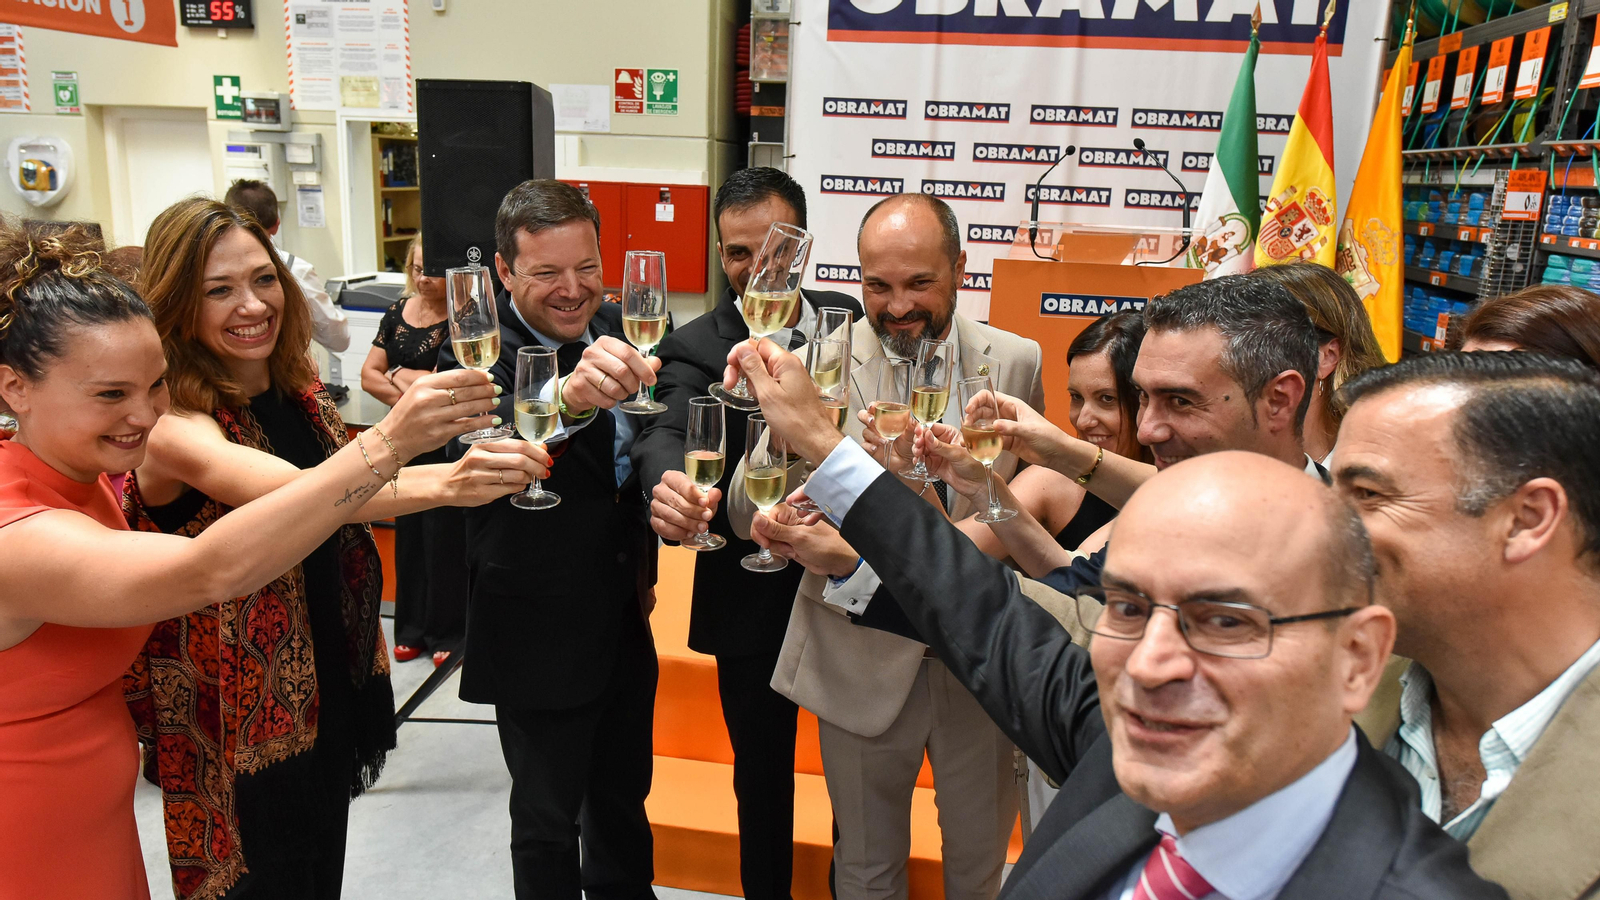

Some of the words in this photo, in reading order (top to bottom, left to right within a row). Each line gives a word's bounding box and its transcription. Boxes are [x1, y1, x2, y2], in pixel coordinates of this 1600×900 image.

[825, 101, 905, 115] OBRAMAT
[927, 105, 1008, 119] OBRAMAT
[1033, 108, 1116, 123] OBRAMAT
[1134, 112, 1220, 127] OBRAMAT
[874, 143, 953, 157] OBRAMAT
[975, 147, 1058, 161] OBRAMAT
[1081, 151, 1166, 167] OBRAMAT
[823, 178, 901, 193] OBRAMAT
[923, 183, 1003, 197] OBRAMAT
[1027, 188, 1109, 203] OBRAMAT
[1127, 192, 1200, 208] OBRAMA
[818, 267, 861, 281] OBRA
[1044, 298, 1144, 314] OBRAMAT
